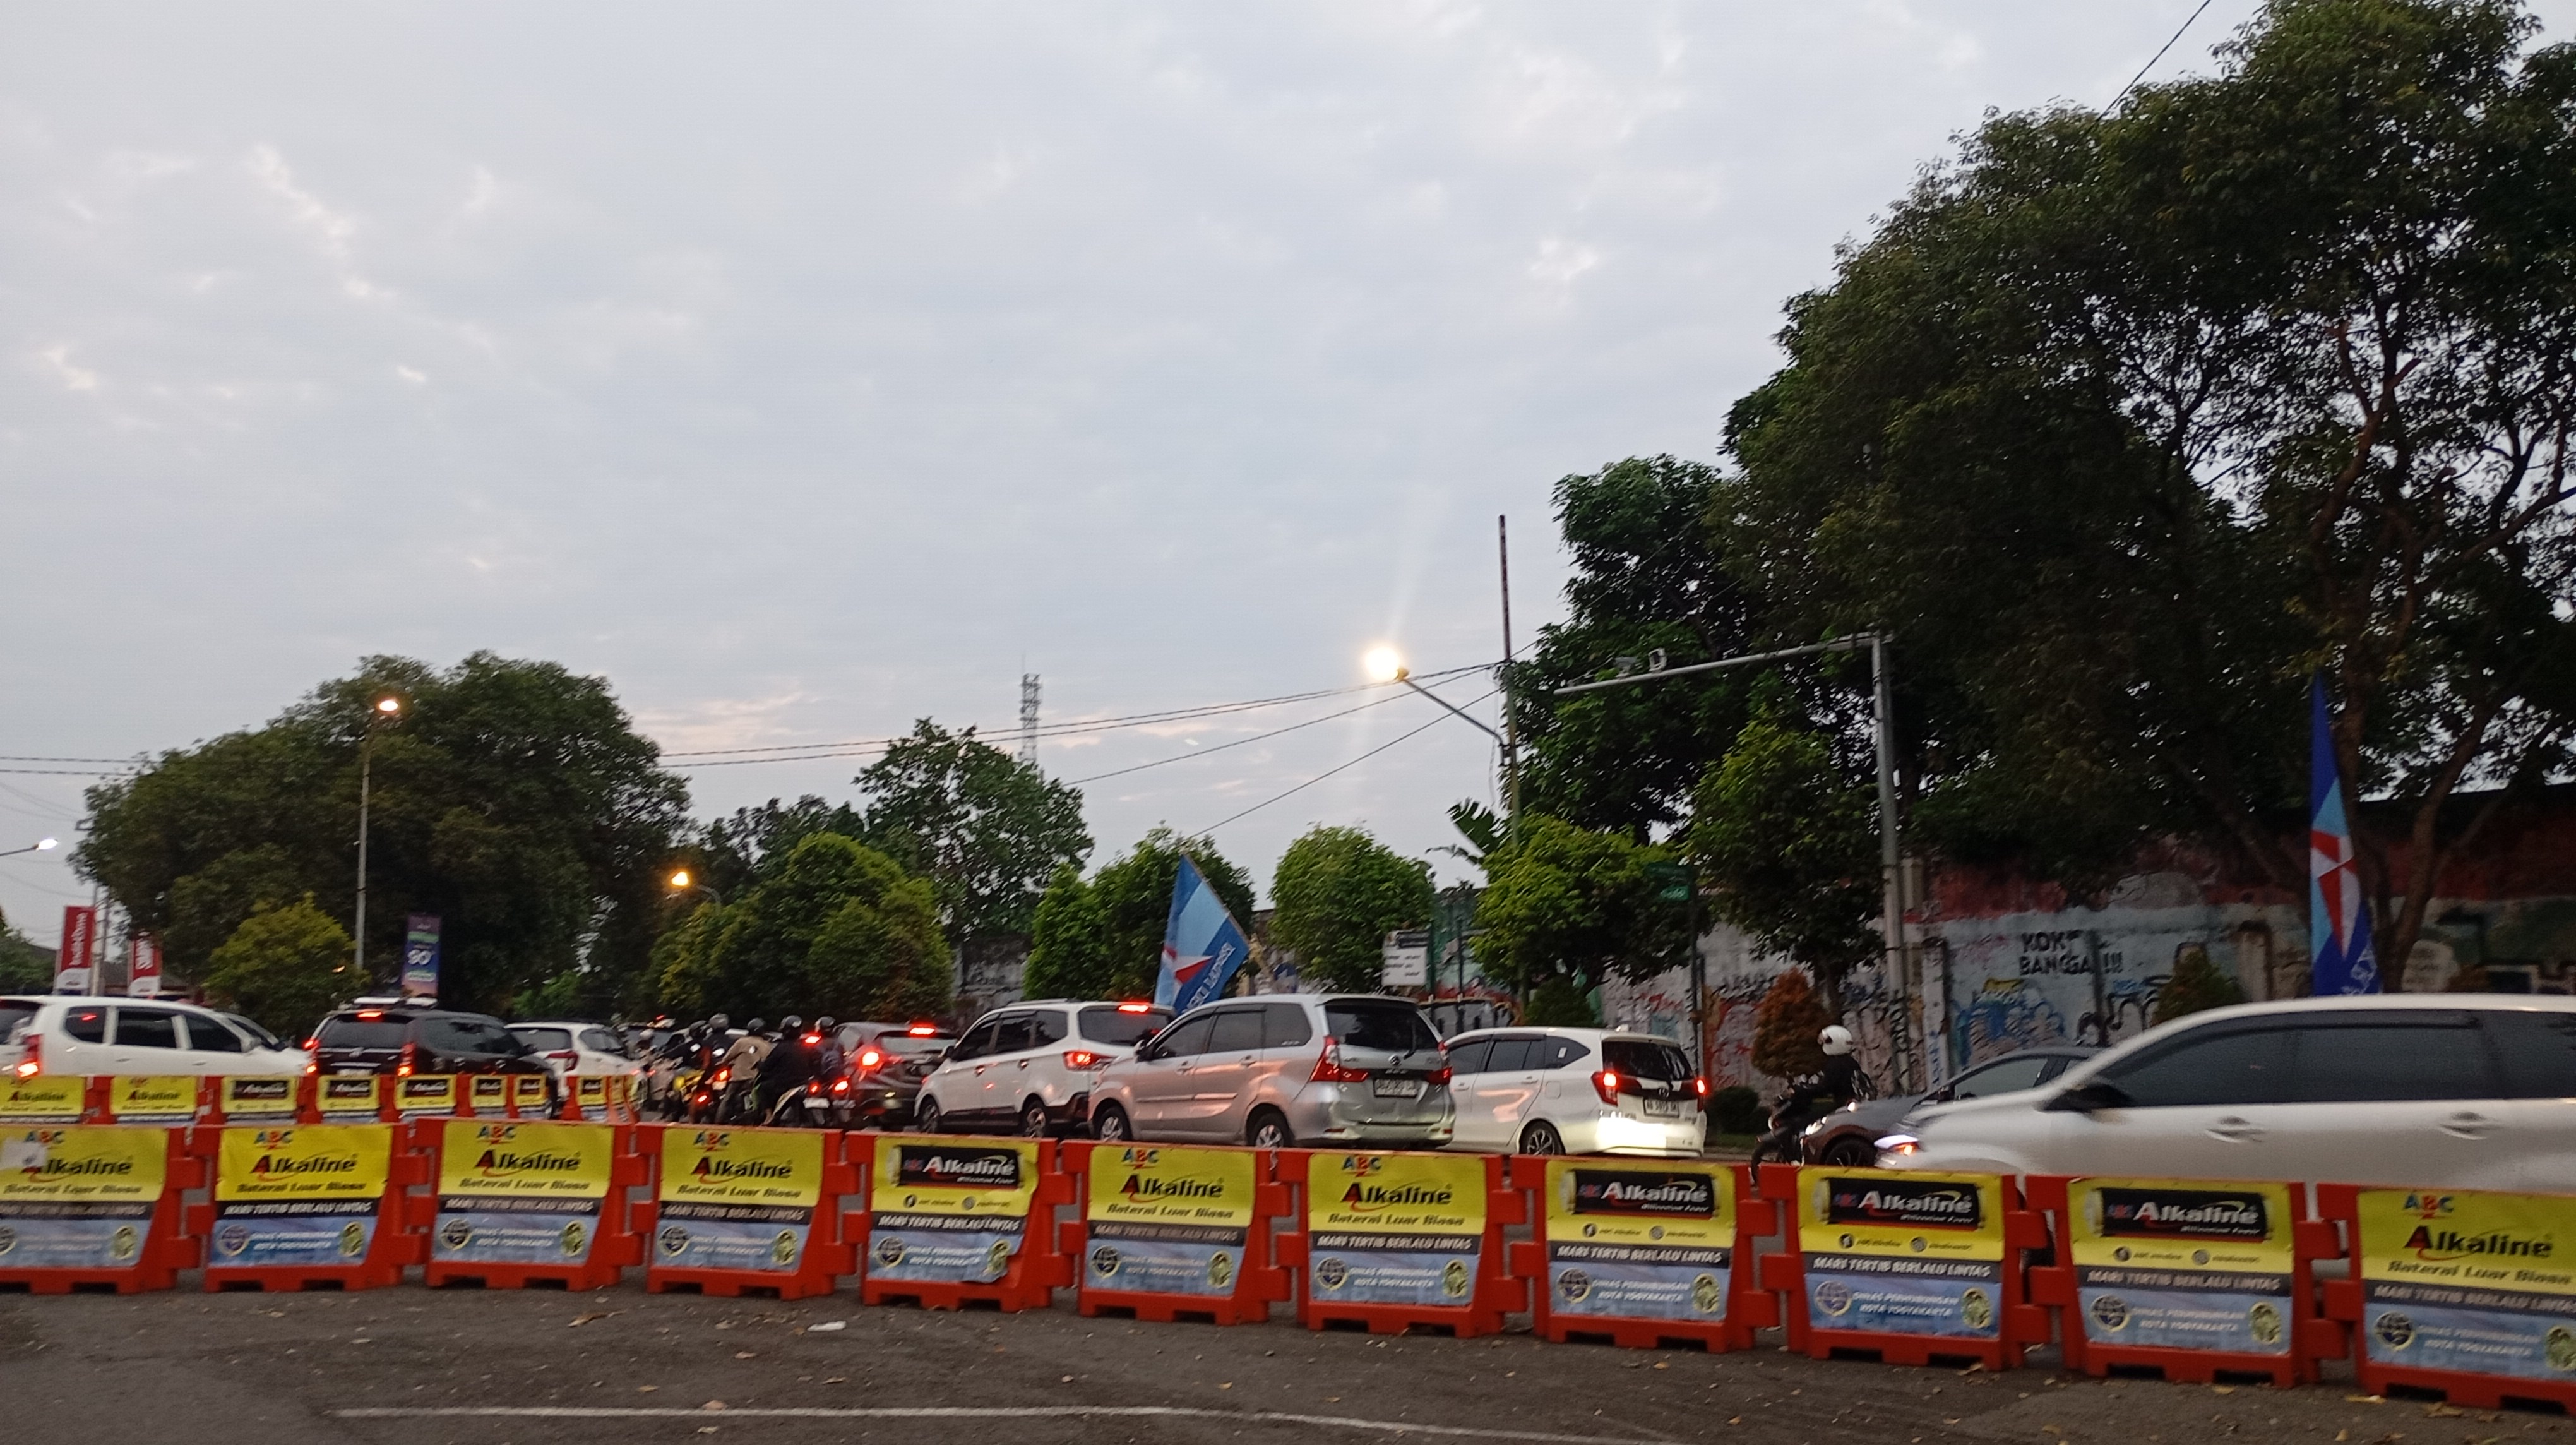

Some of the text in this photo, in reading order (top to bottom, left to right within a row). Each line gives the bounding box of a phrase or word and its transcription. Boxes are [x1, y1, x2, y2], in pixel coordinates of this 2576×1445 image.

[24, 1130, 64, 1144] ABC
[254, 1130, 294, 1144] ABC
[478, 1125, 516, 1139] ABC
[693, 1131, 730, 1146] ABC
[250, 1154, 357, 1174] Alkaline
[474, 1149, 580, 1171] Alkaline
[923, 1156, 1015, 1175] Alkaline
[1122, 1148, 1159, 1163] ABC
[1342, 1156, 1381, 1170] ABC
[691, 1156, 792, 1179] Alkaline
[1120, 1174, 1224, 1197] Alkaline
[1340, 1181, 1452, 1205] Alkaline
[1601, 1182, 1707, 1202] Alkaline
[1858, 1190, 1973, 1213] Alkaline
[2403, 1194, 2454, 1213] ABC
[2133, 1201, 2259, 1225] Alkaline
[2404, 1225, 2552, 1257] Alkaline
